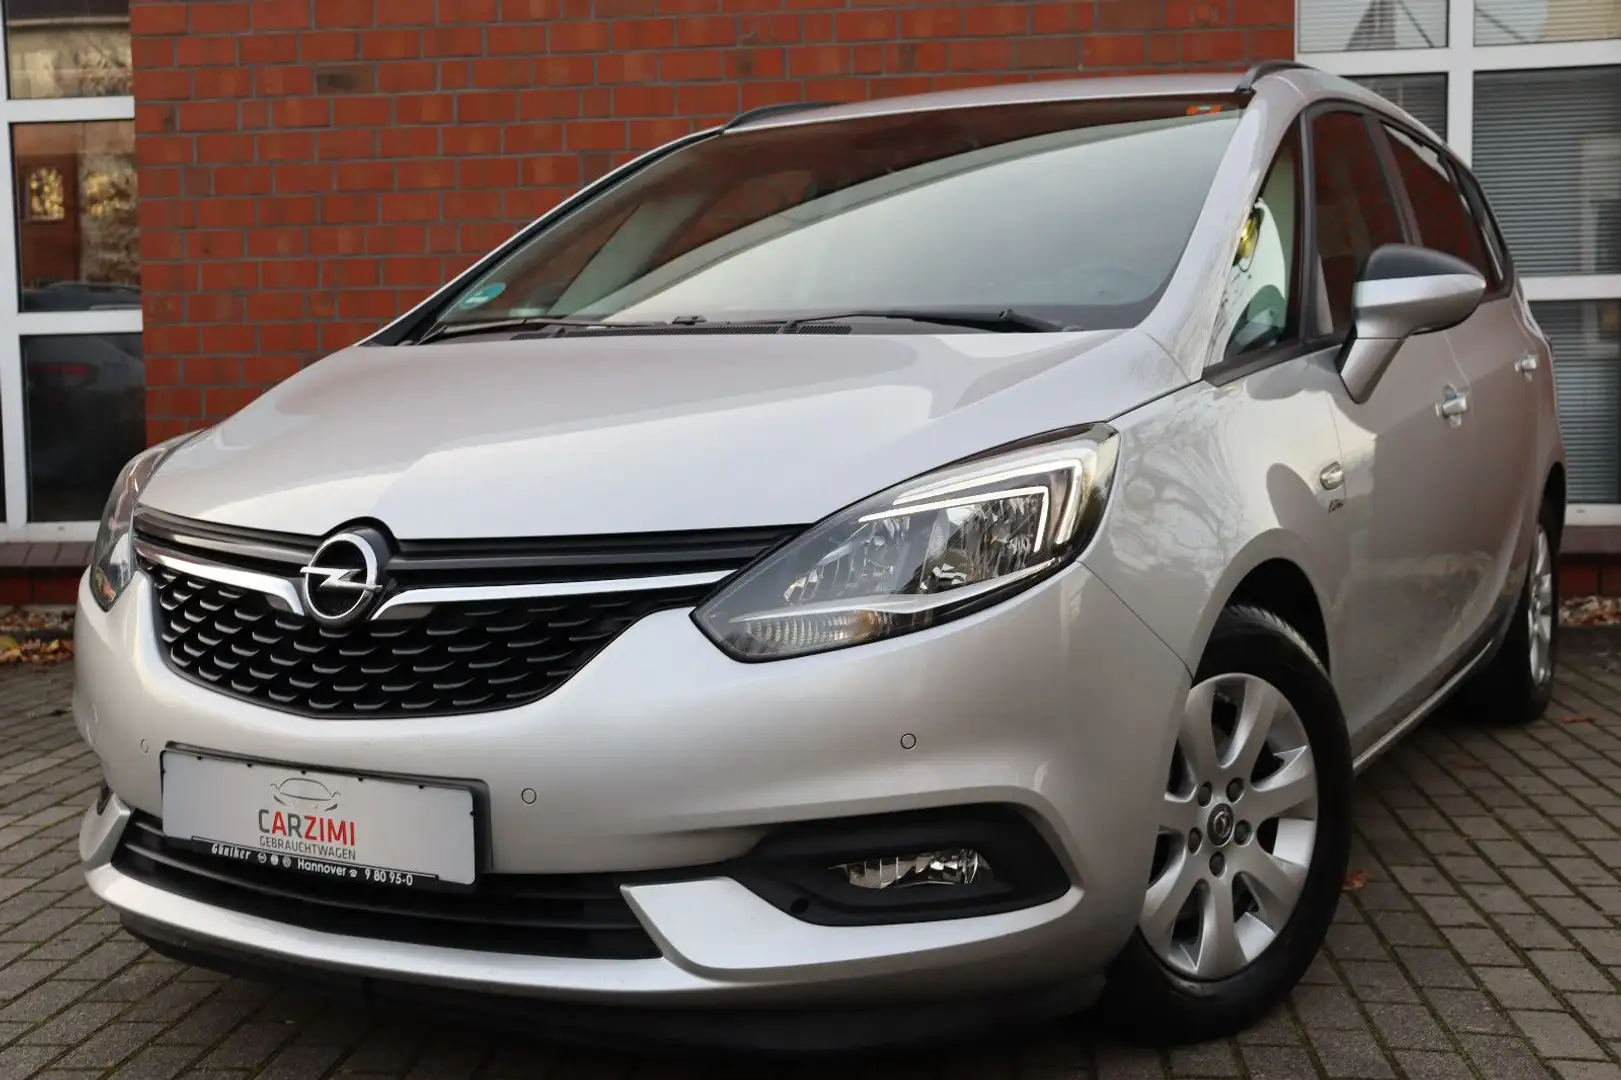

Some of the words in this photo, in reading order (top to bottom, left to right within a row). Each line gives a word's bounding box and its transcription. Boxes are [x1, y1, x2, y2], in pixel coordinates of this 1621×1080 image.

[258, 808, 355, 846] CARZIMI
[259, 835, 356, 860] GEBRAUCHTWAGEN
[297, 858, 347, 876] Hannover
[364, 868, 371, 880] 9
[373, 869, 387, 882] 80
[389, 872, 413, 886] 95-0
